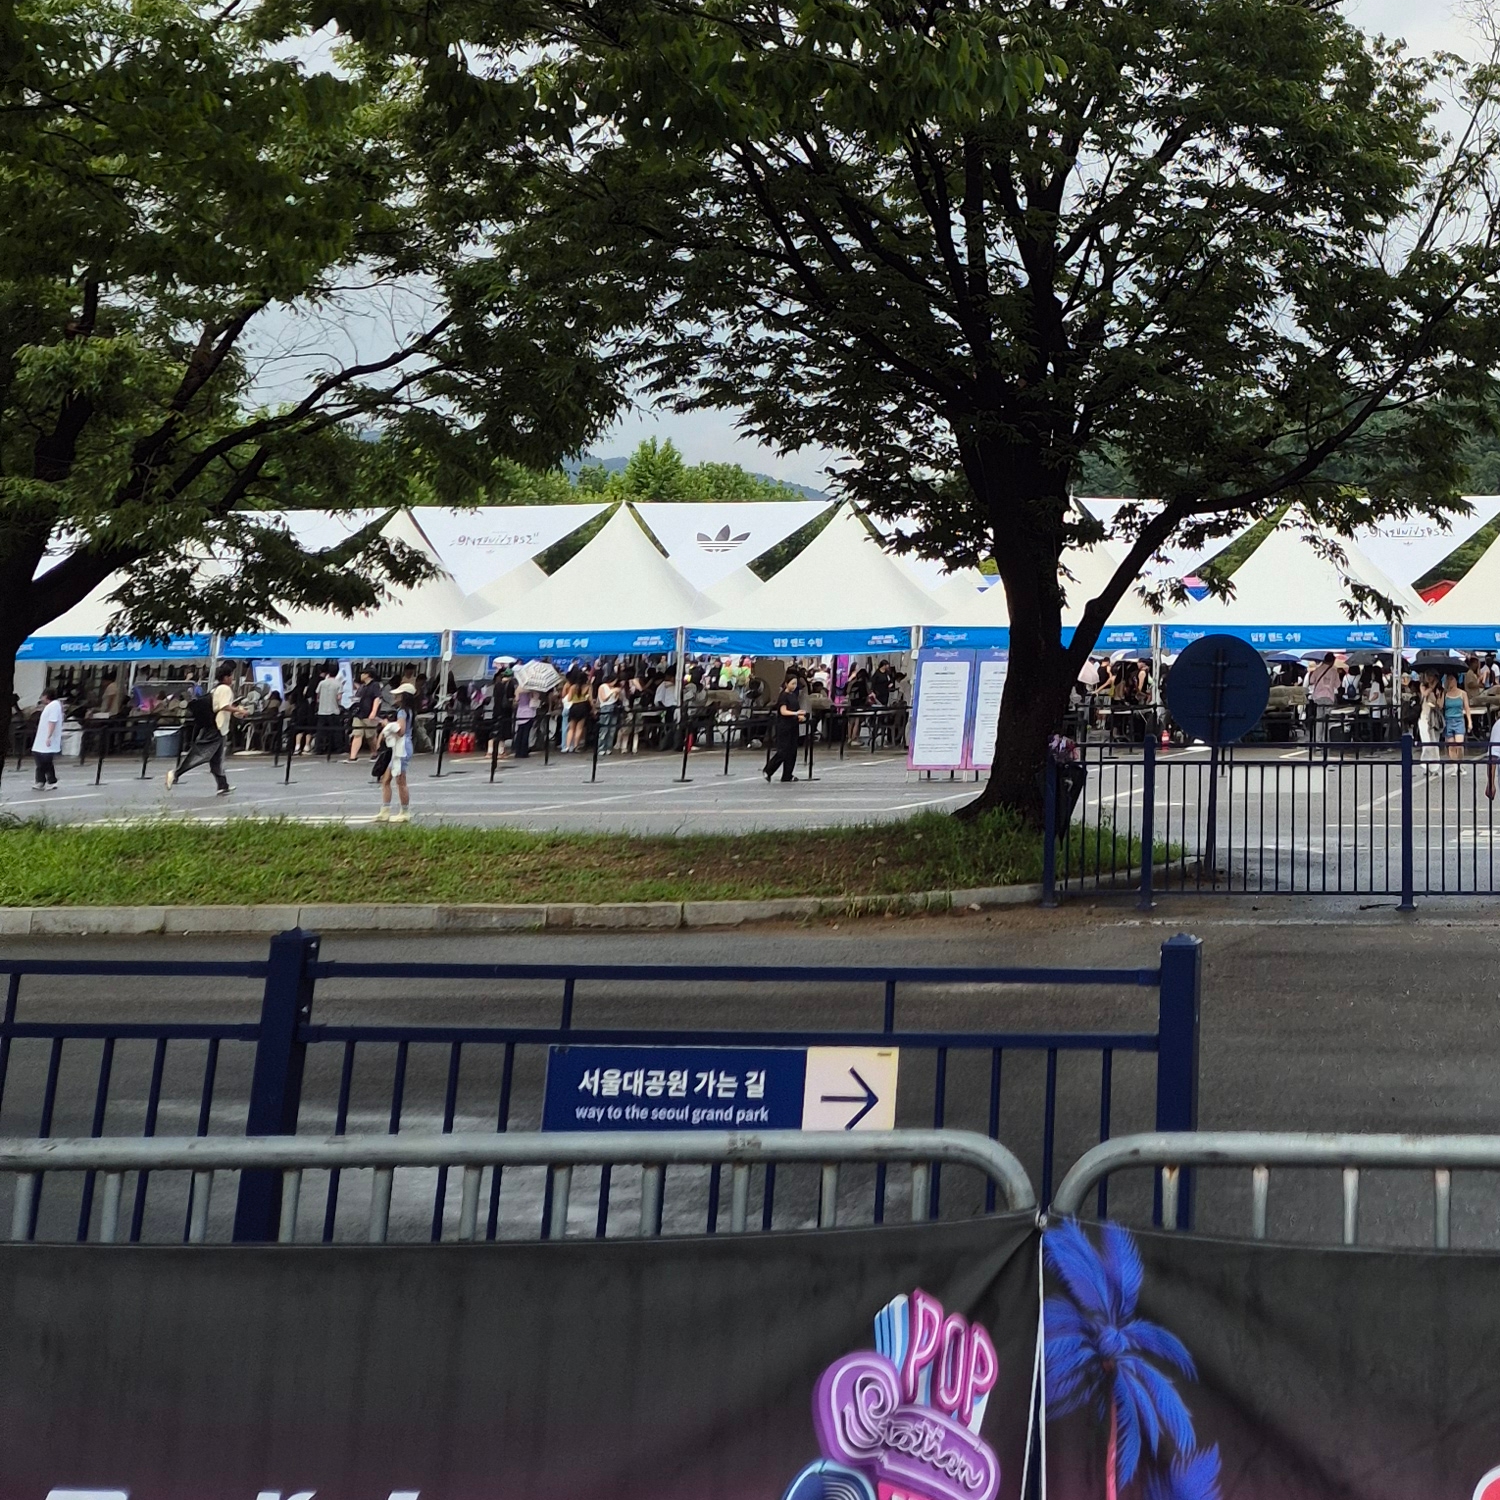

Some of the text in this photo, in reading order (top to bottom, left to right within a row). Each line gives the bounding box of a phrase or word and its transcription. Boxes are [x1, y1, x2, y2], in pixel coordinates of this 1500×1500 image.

[575, 1105, 769, 1124] way to the seoul grand park
[578, 1068, 766, 1098] 서울대공원 가는 길
[900, 1287, 998, 1428] POP
[841, 1370, 984, 1491] Station
